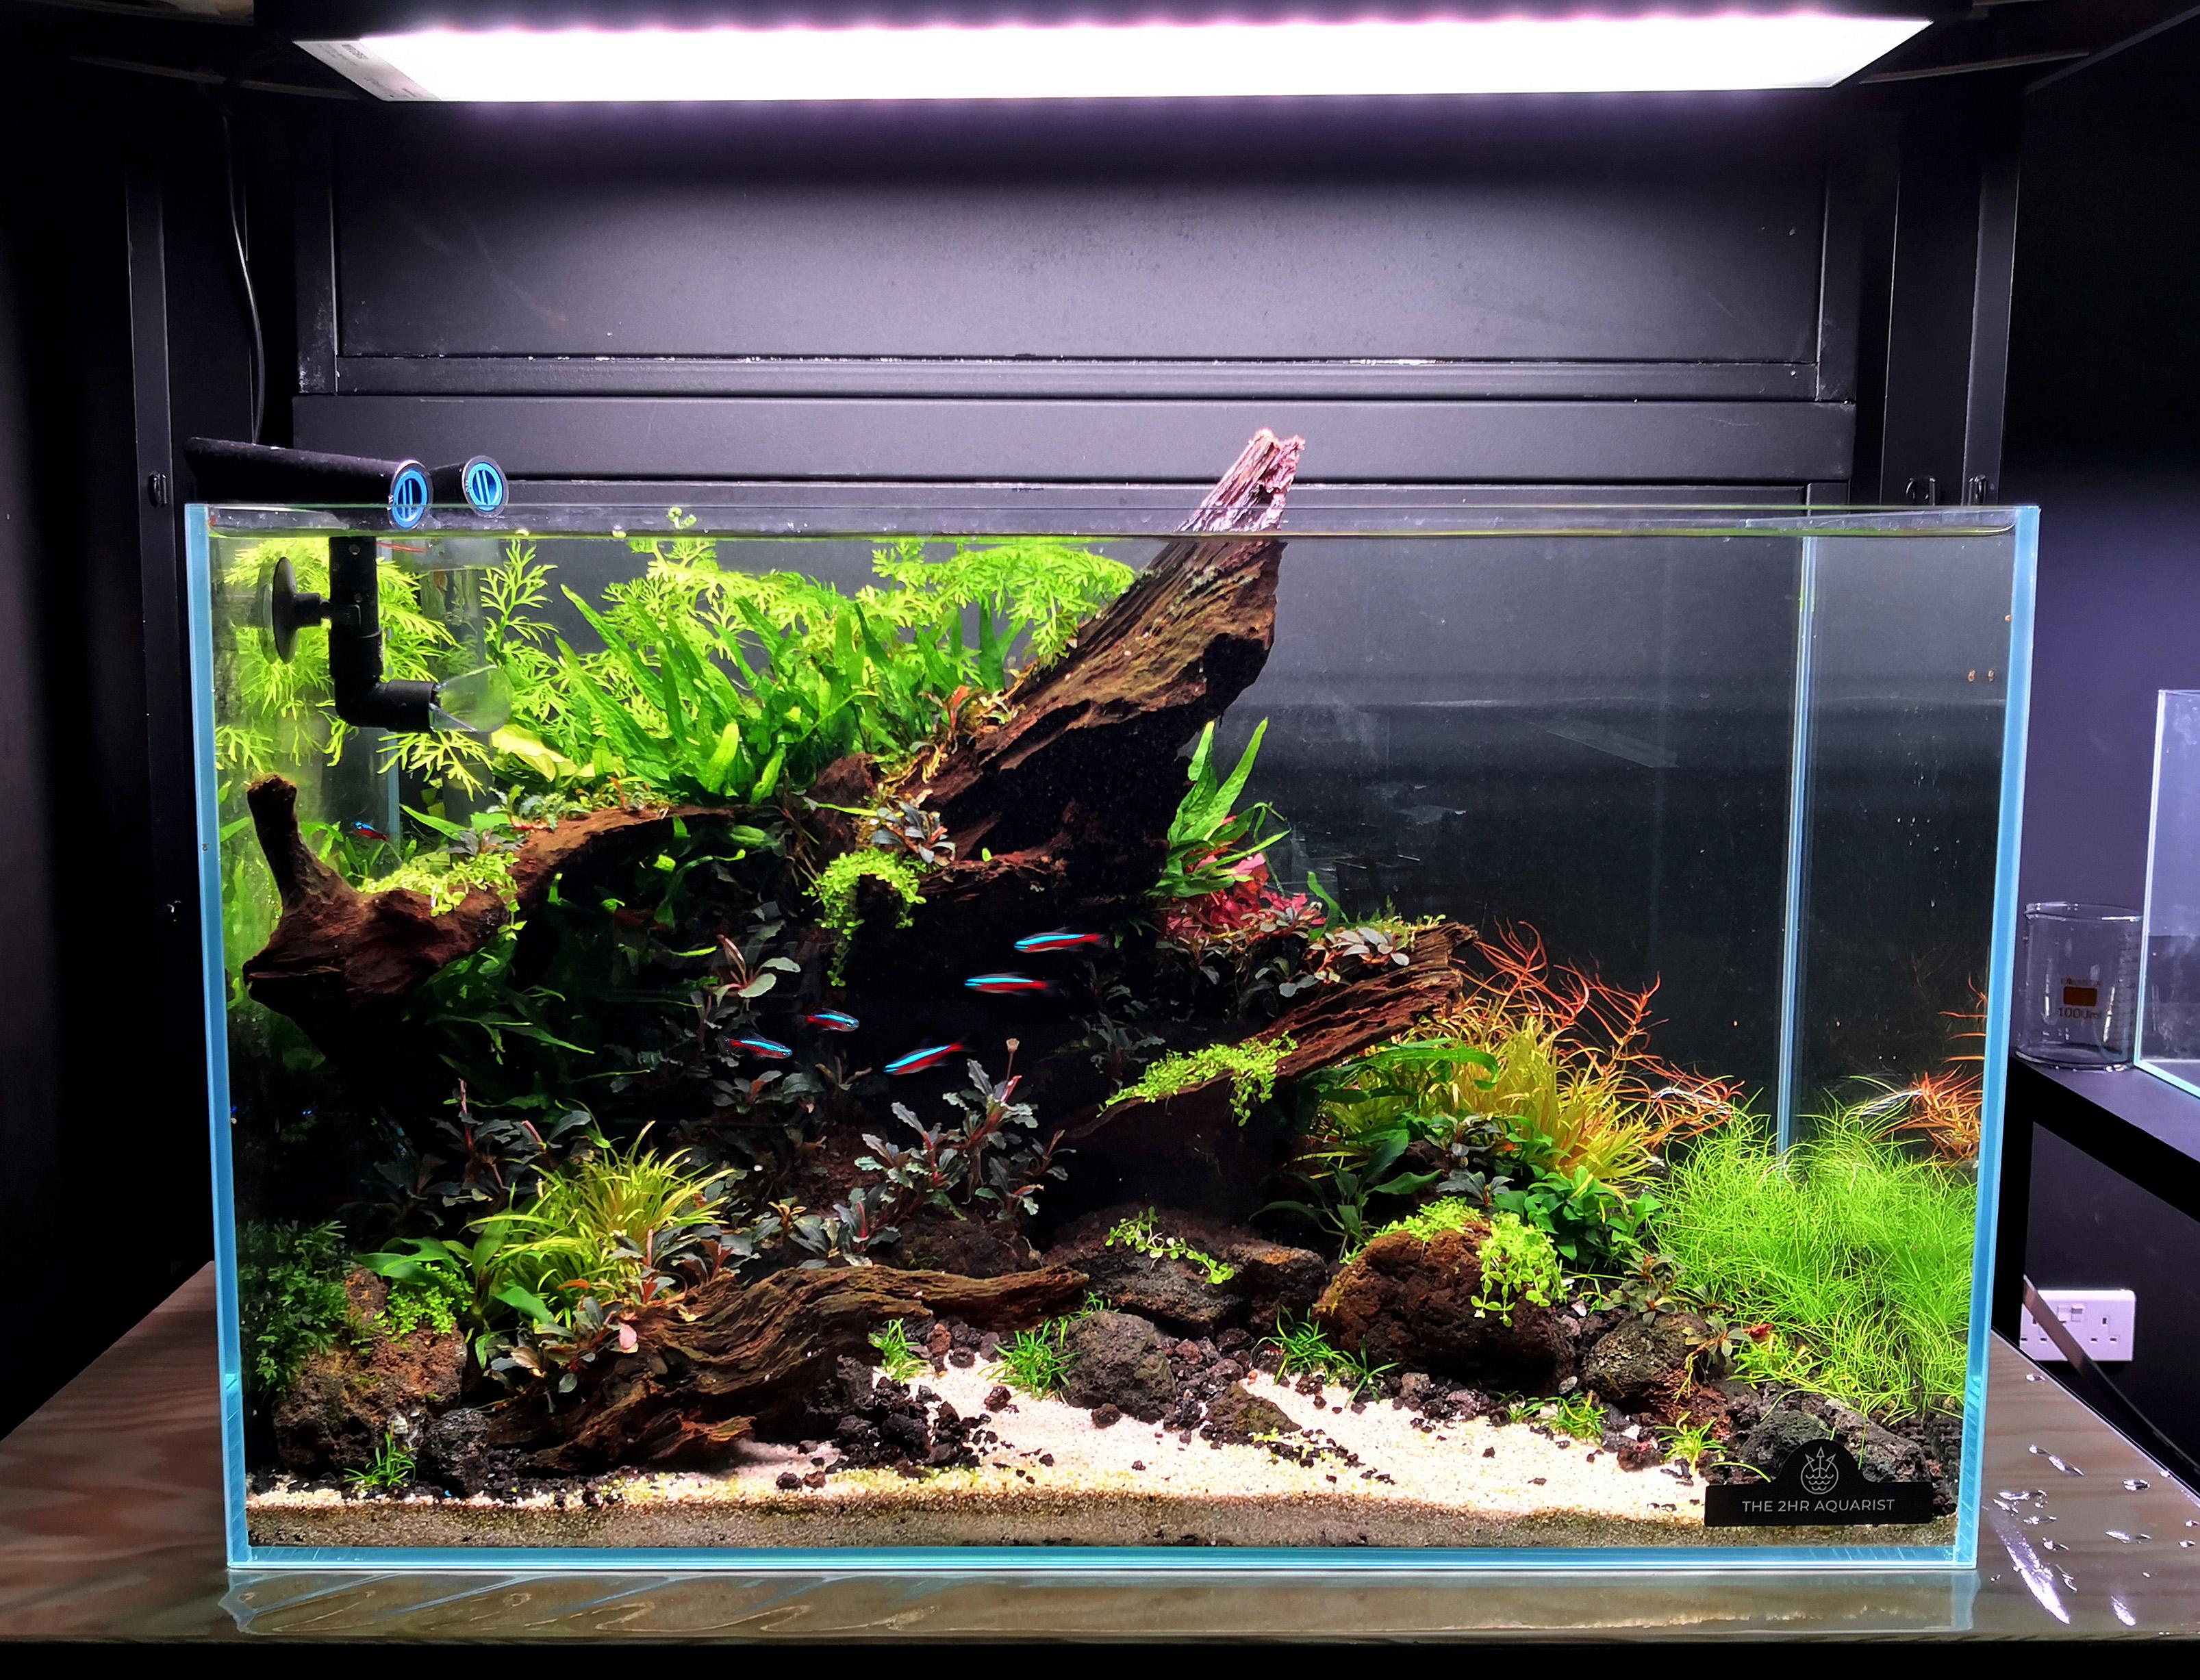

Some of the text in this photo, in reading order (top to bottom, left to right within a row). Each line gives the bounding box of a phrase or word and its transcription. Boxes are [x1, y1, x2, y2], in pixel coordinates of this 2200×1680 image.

[1741, 1499, 1895, 1512] THE 2HR AQUARIST
